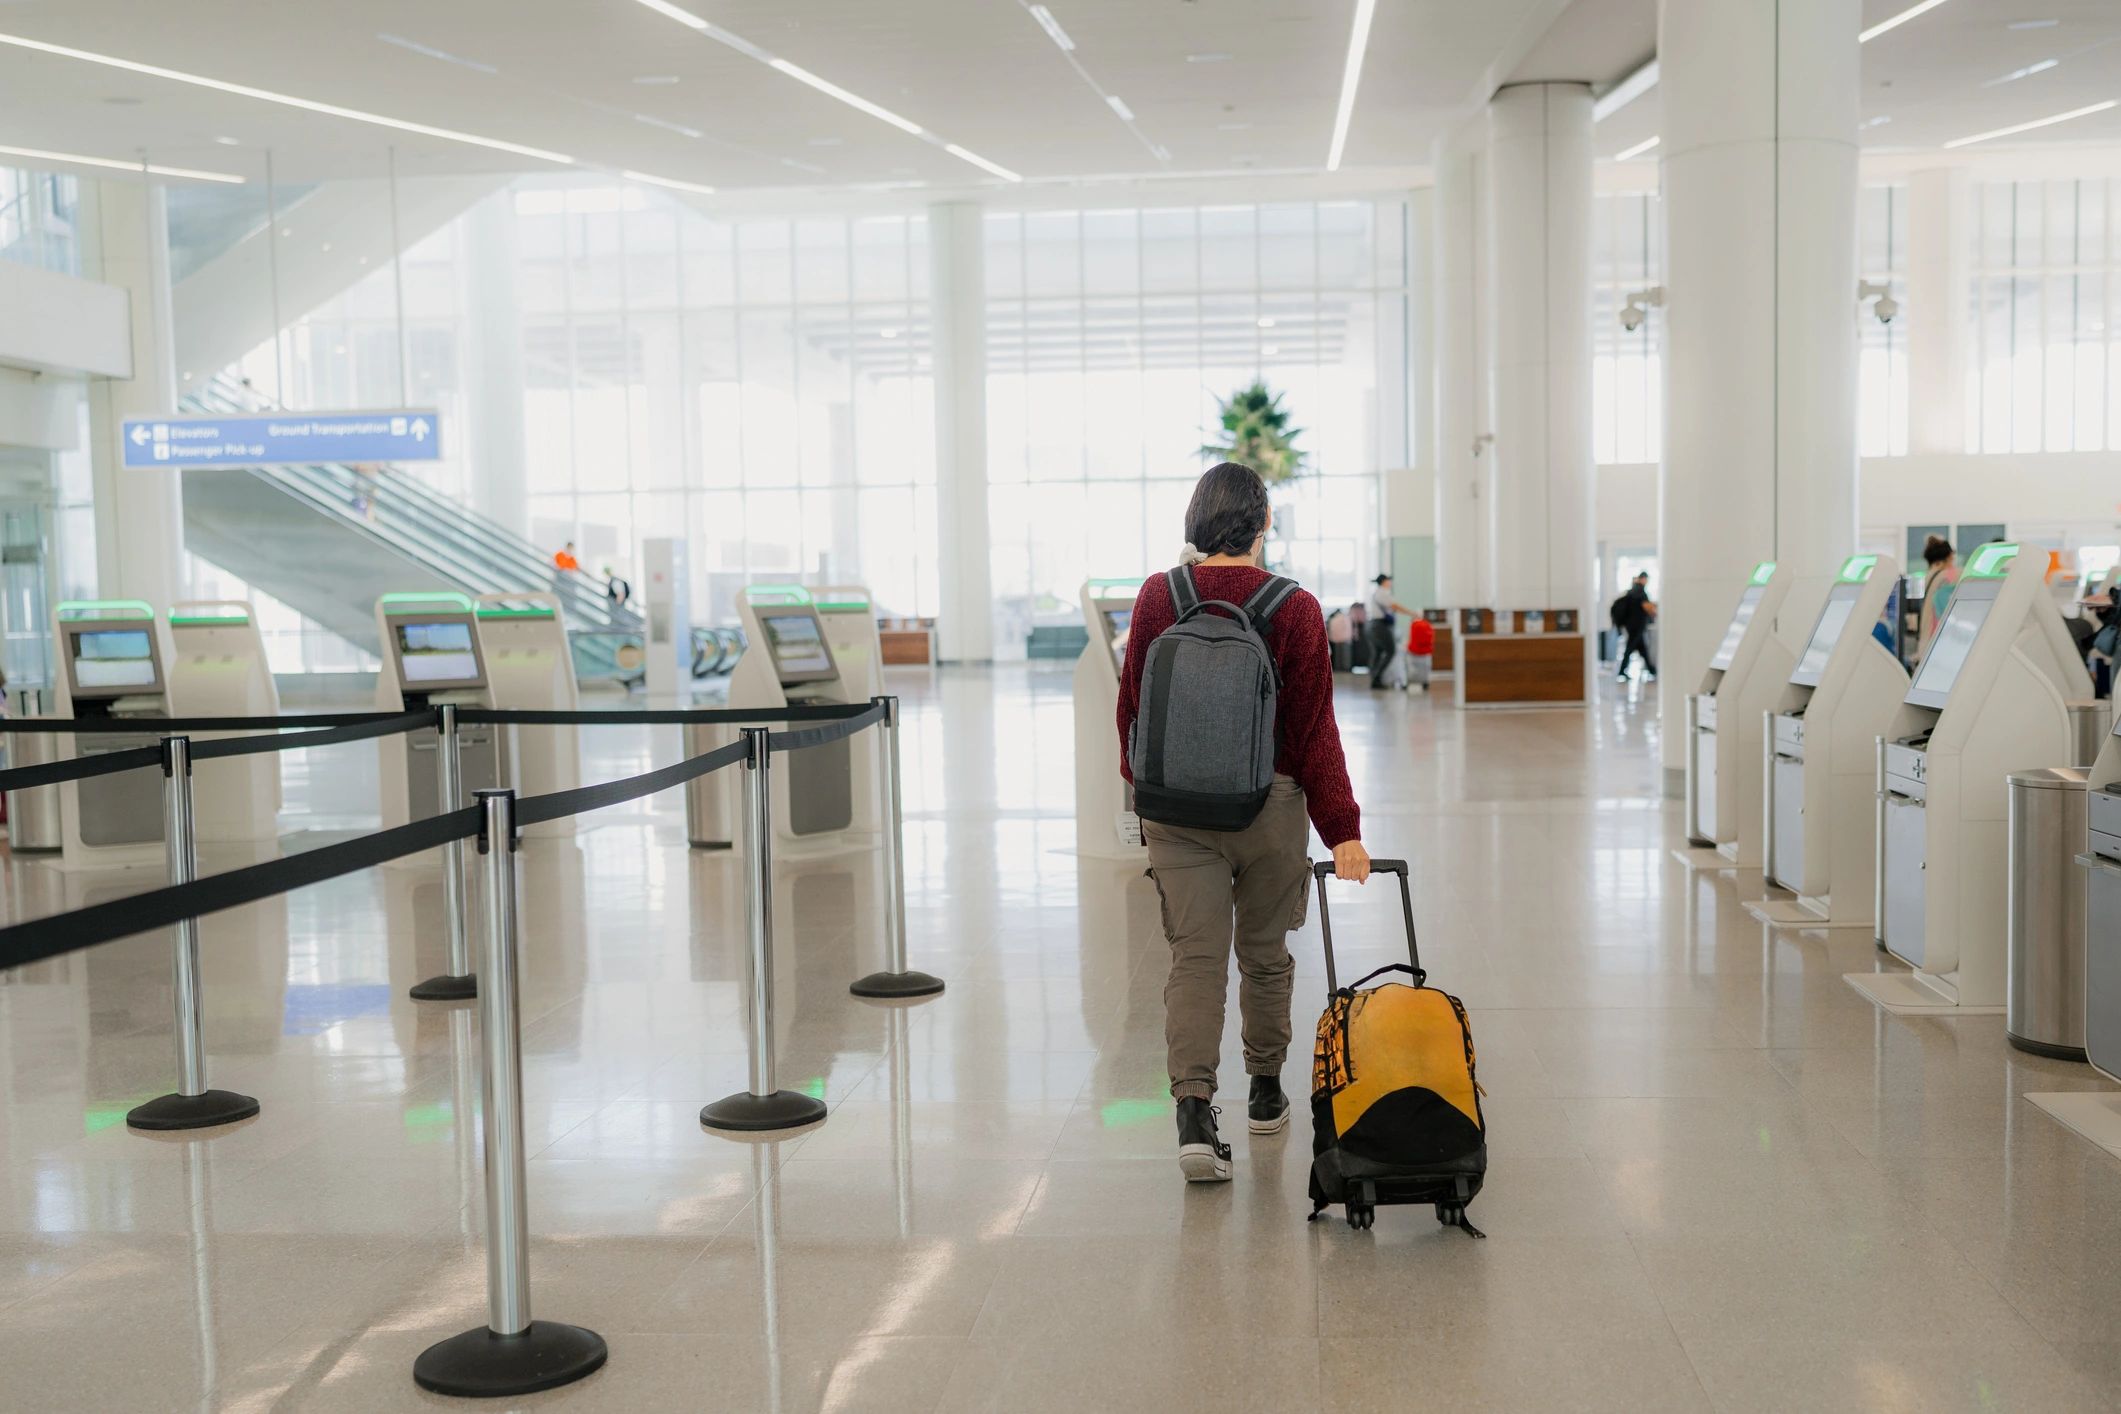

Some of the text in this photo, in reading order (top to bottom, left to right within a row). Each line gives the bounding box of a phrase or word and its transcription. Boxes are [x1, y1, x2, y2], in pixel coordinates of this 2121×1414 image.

[171, 426, 219, 439] Elevators
[268, 422, 389, 436] Ground Transportation
[171, 445, 223, 459] Passenger
